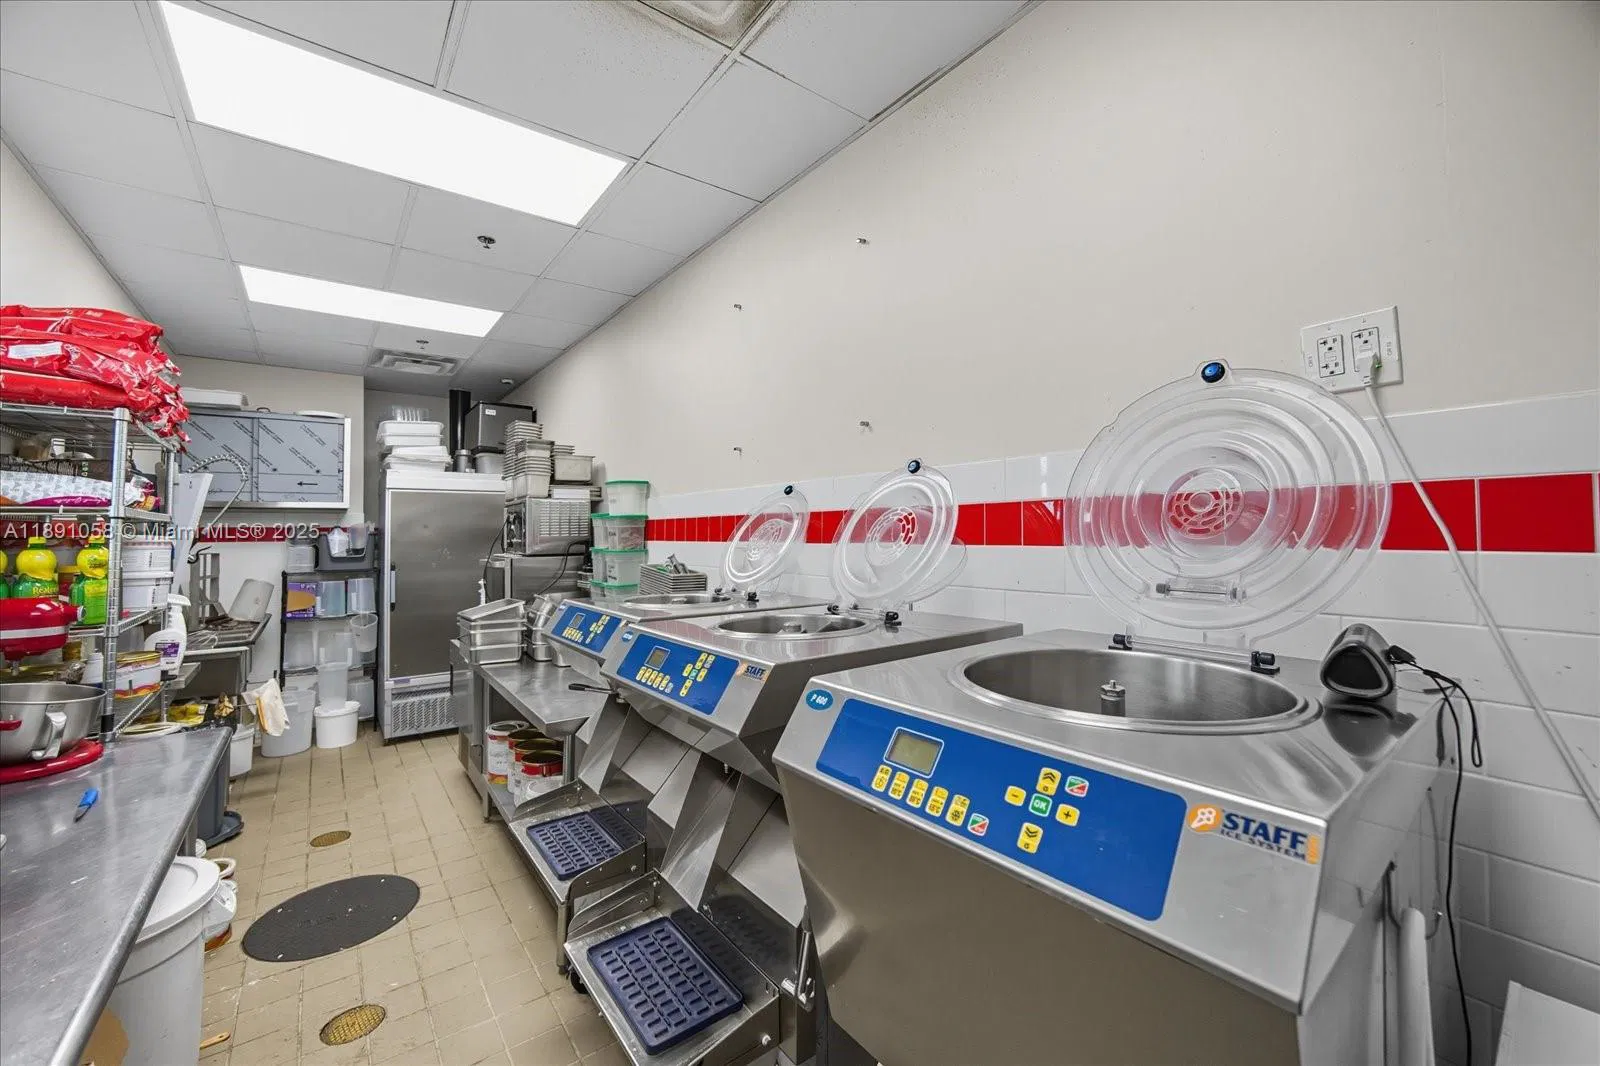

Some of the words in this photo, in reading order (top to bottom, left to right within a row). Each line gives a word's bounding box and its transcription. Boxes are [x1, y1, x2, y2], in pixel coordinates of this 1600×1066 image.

[744, 665, 767, 677] STAFF
[1033, 799, 1047, 811] OK
[1222, 812, 1308, 850] STAFF
[1220, 828, 1243, 841] ICE
[1247, 838, 1306, 862] SYSTEM
